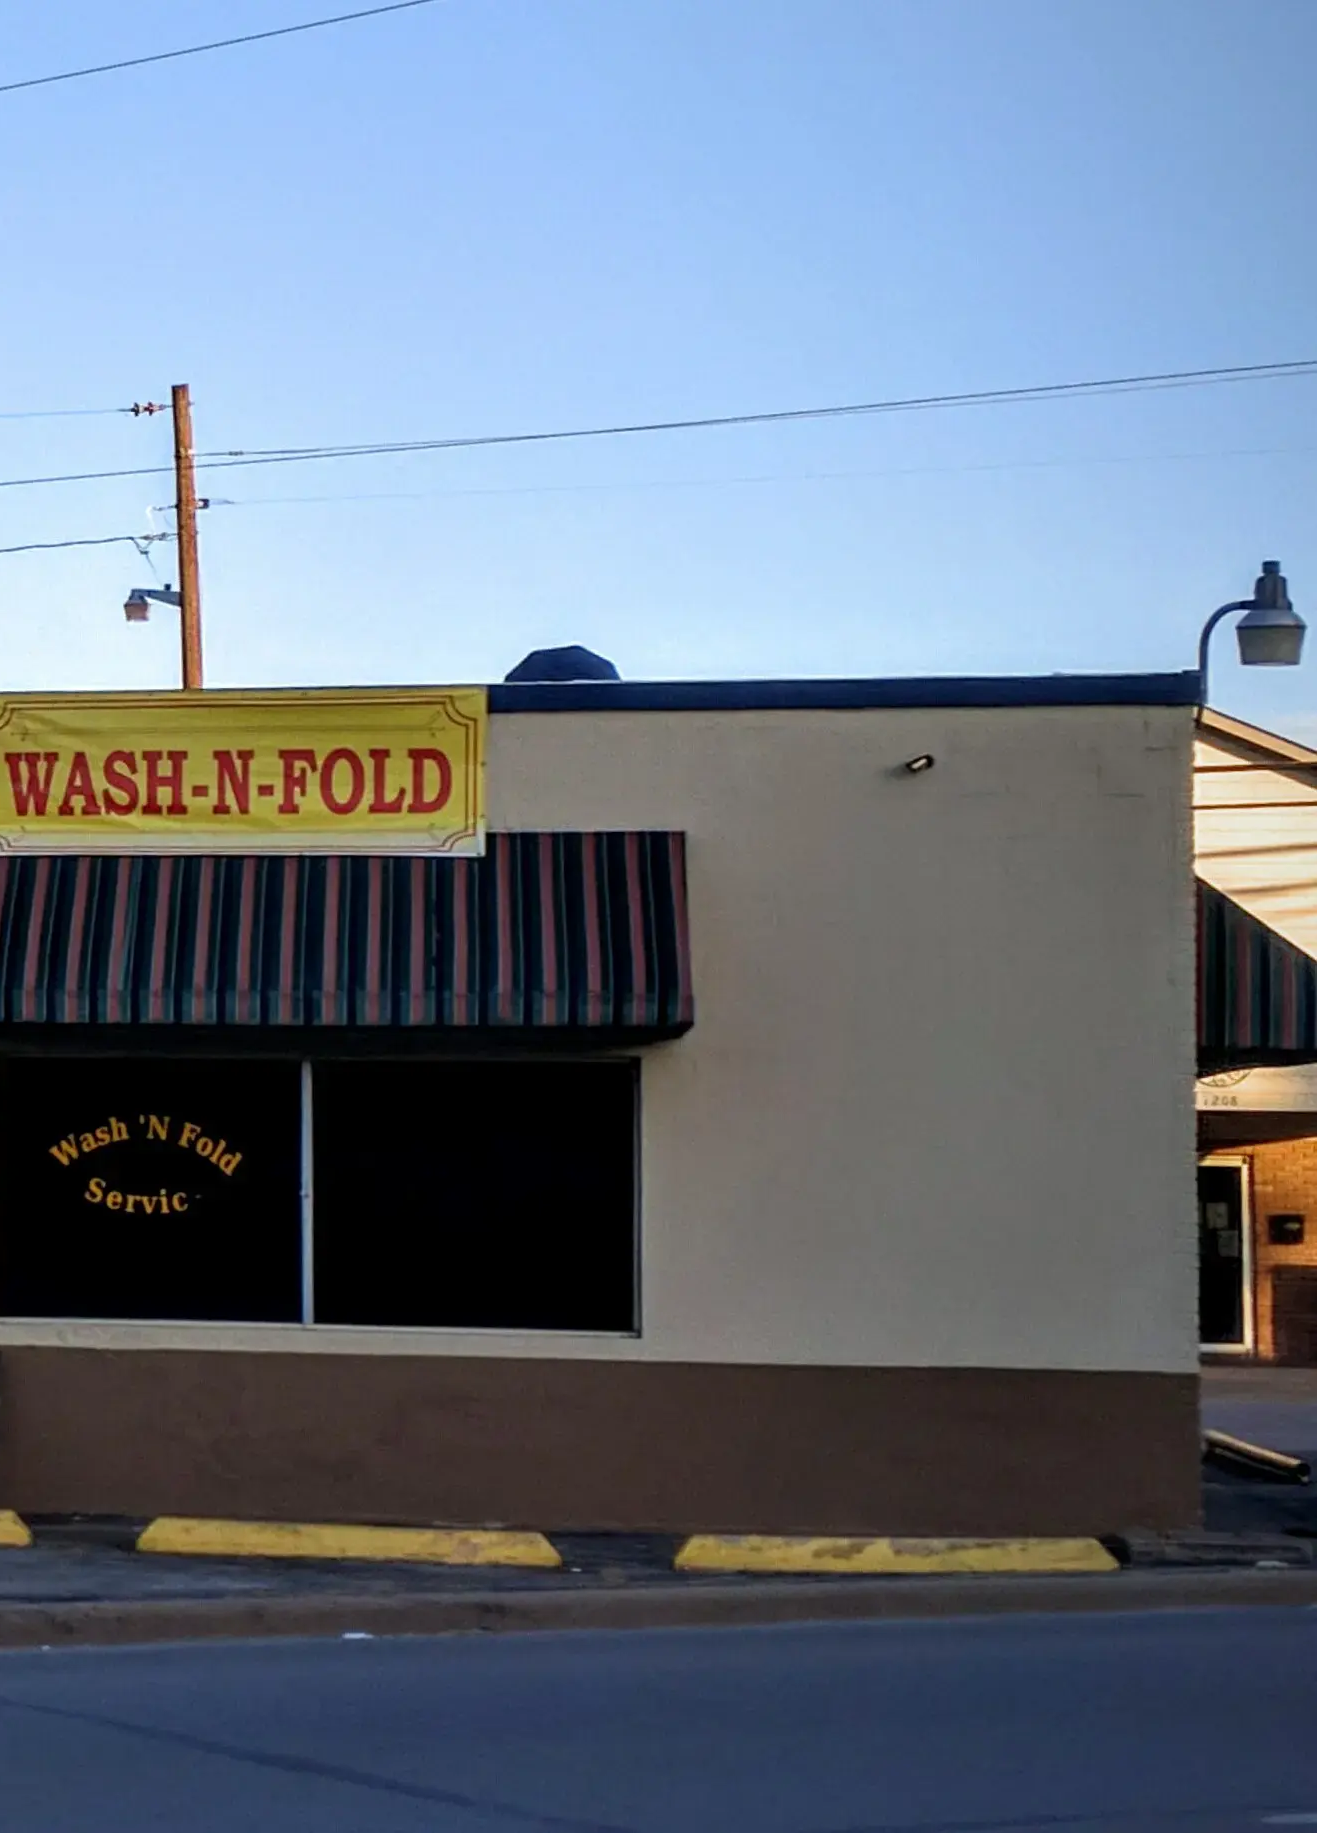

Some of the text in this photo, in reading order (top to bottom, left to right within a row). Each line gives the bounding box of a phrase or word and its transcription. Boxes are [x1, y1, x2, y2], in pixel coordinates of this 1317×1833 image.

[4, 747, 453, 817] WASH-N-FOLD
[48, 1113, 243, 1176] Wash 'N Fold
[83, 1176, 191, 1215] Servic
